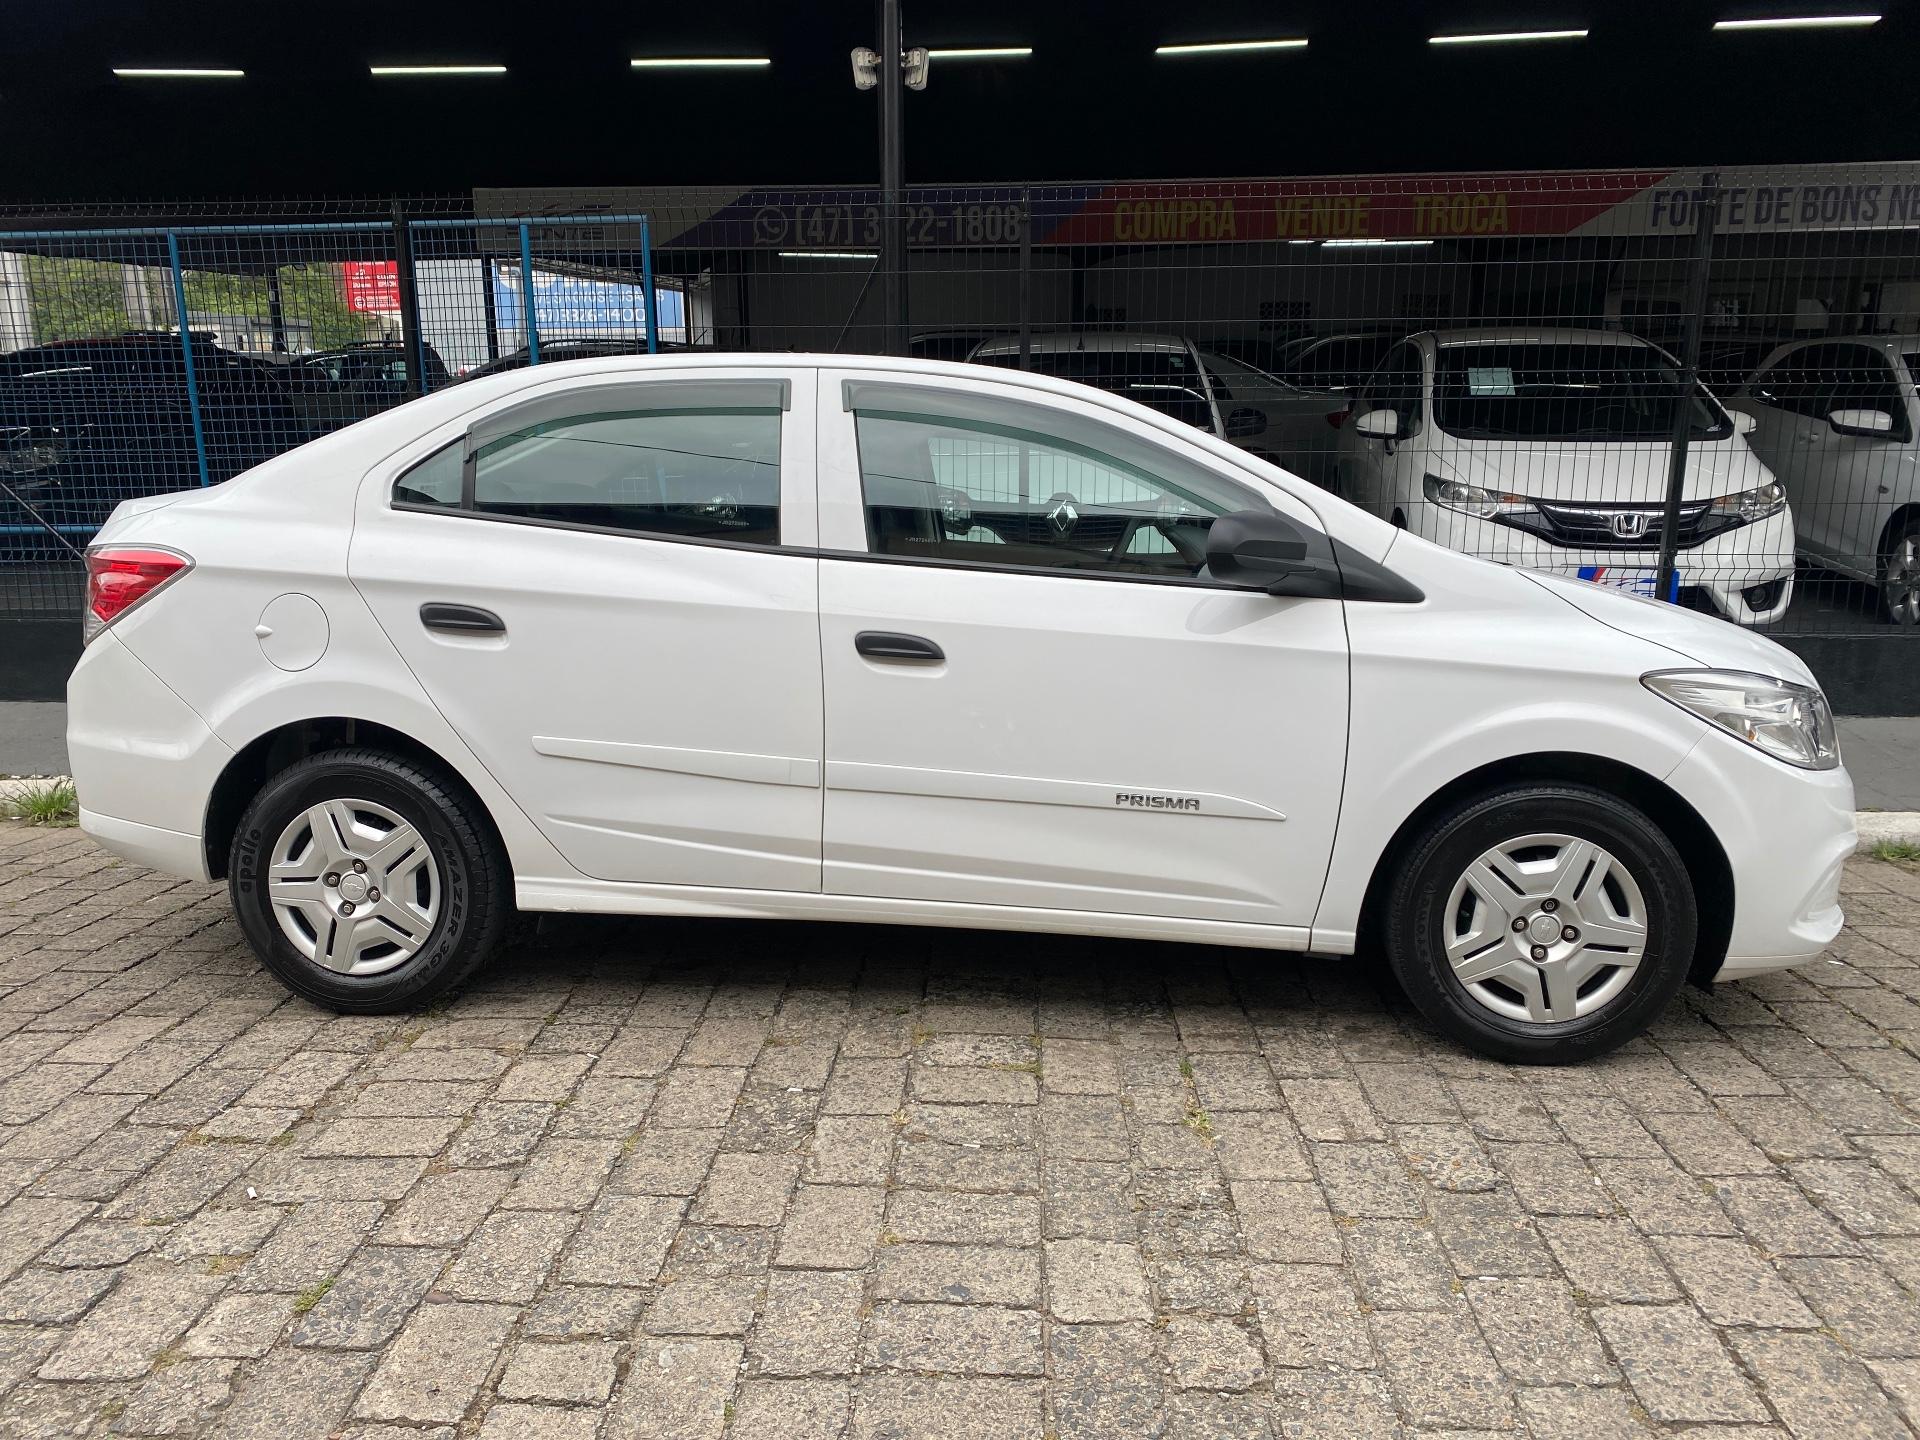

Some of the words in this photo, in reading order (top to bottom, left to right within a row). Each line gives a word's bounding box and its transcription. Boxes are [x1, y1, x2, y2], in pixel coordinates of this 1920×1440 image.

[864, 204, 1022, 243] 322-1808
[1114, 199, 1236, 240] COMPRA
[1275, 197, 1372, 237] VENDE
[1411, 193, 1509, 234] TROCA
[1754, 187, 1794, 225] DE
[1800, 185, 1882, 223] BONS
[1115, 793, 1200, 811] PRISMA
[240, 829, 261, 893] apollo
